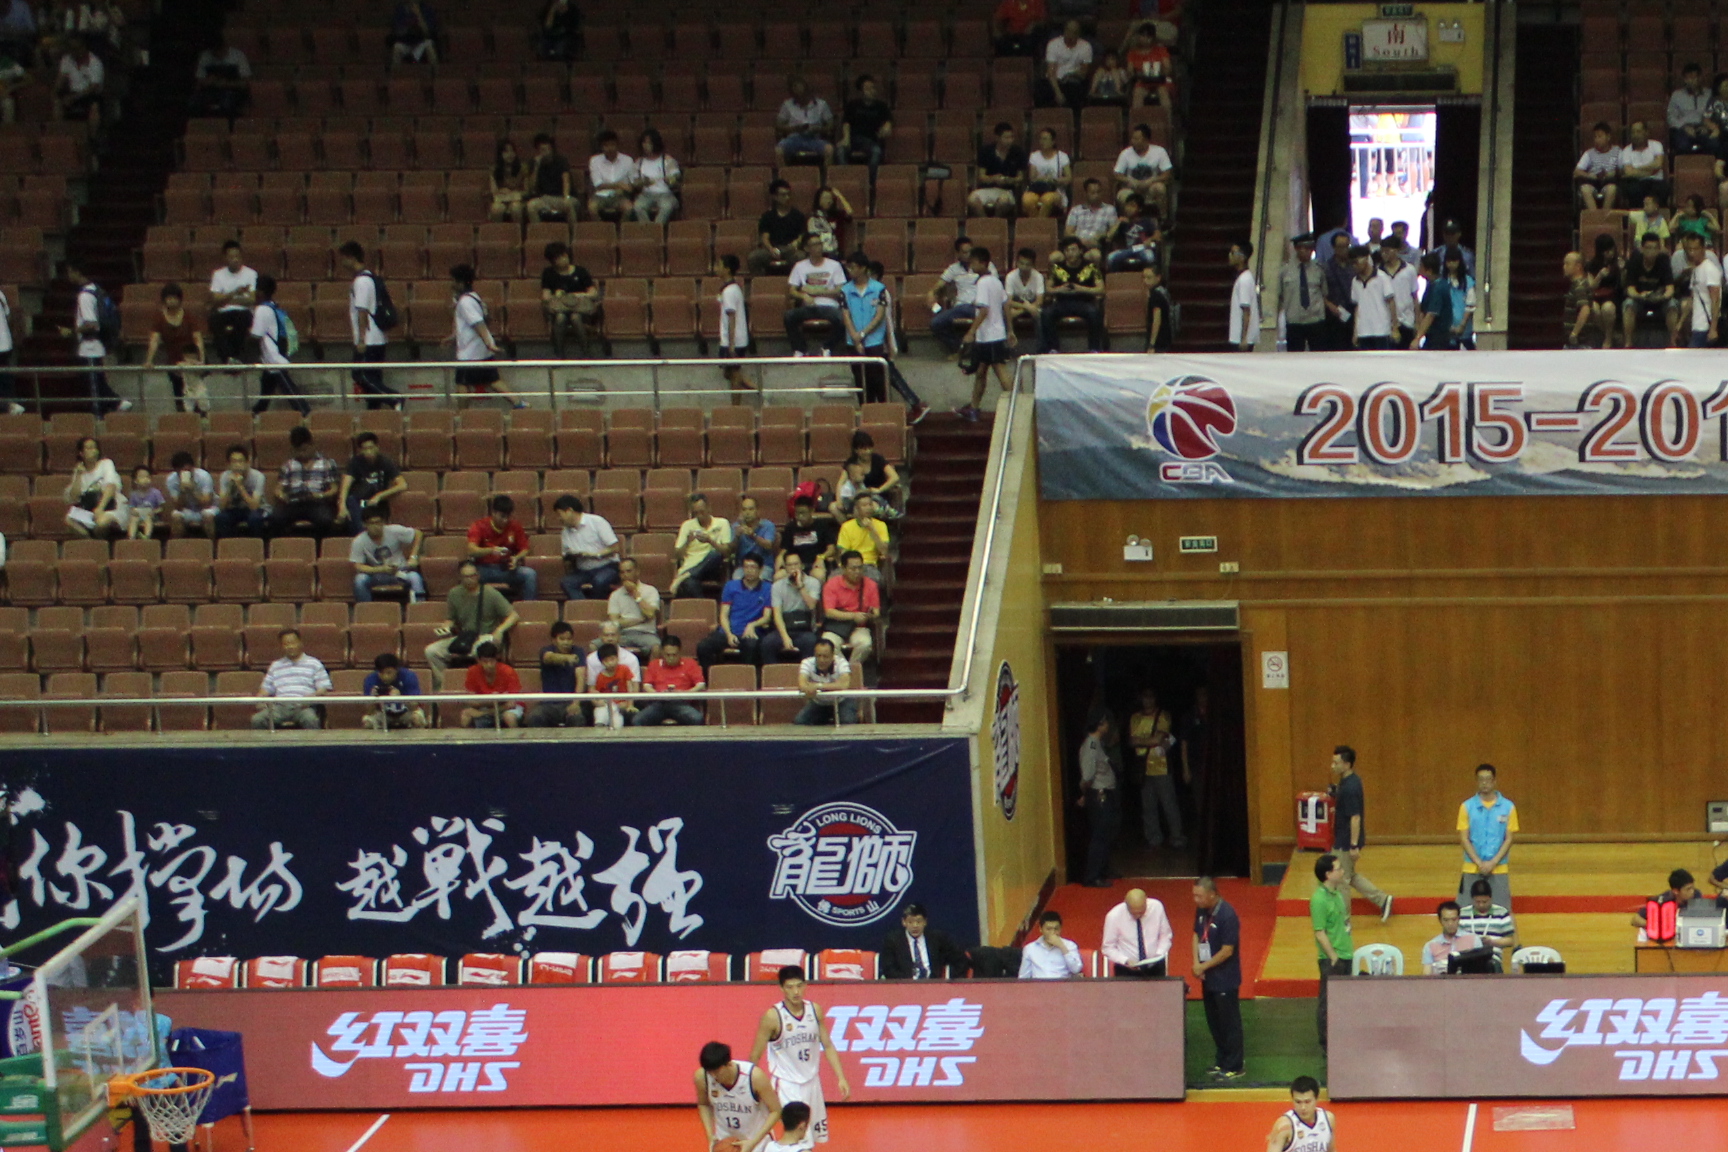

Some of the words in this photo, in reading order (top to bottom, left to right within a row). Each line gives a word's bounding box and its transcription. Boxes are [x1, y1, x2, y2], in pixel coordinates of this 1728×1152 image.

[1160, 462, 1234, 484] CBA
[816, 812, 847, 827] LONG
[850, 813, 882, 834] LIONS
[832, 906, 865, 916] SPORTS
[866, 900, 880, 912] 山
[313, 1004, 528, 1067] 红双喜
[798, 1051, 810, 1062] 45
[405, 1061, 521, 1093] DHS
[860, 1055, 977, 1087] DHS
[726, 1116, 741, 1130] 13
